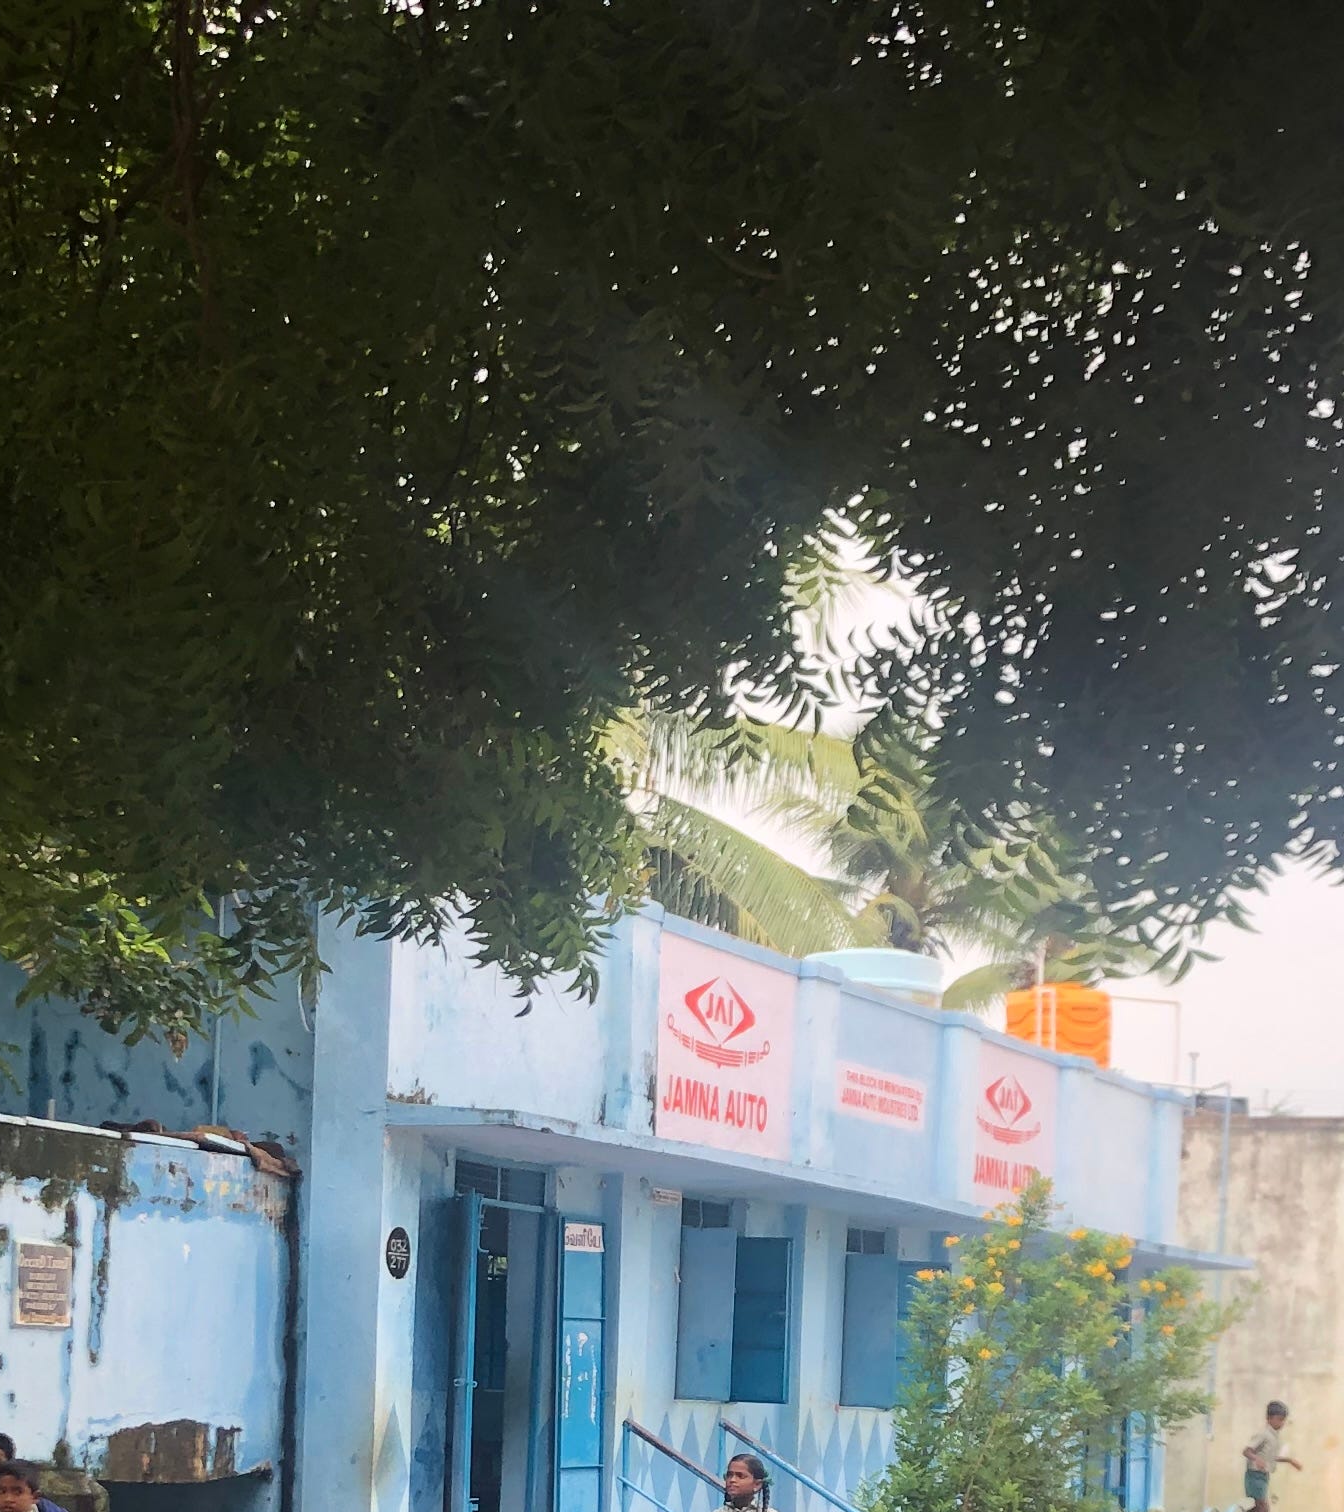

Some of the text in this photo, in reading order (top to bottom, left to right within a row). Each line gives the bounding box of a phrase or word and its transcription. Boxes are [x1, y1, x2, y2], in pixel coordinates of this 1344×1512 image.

[706, 993, 734, 1027] JAI
[663, 1074, 768, 1133] JAMNA AUTO
[973, 1153, 1038, 1191] JAMNA AUT
[390, 1238, 408, 1252] 032
[390, 1255, 407, 1270] 277
